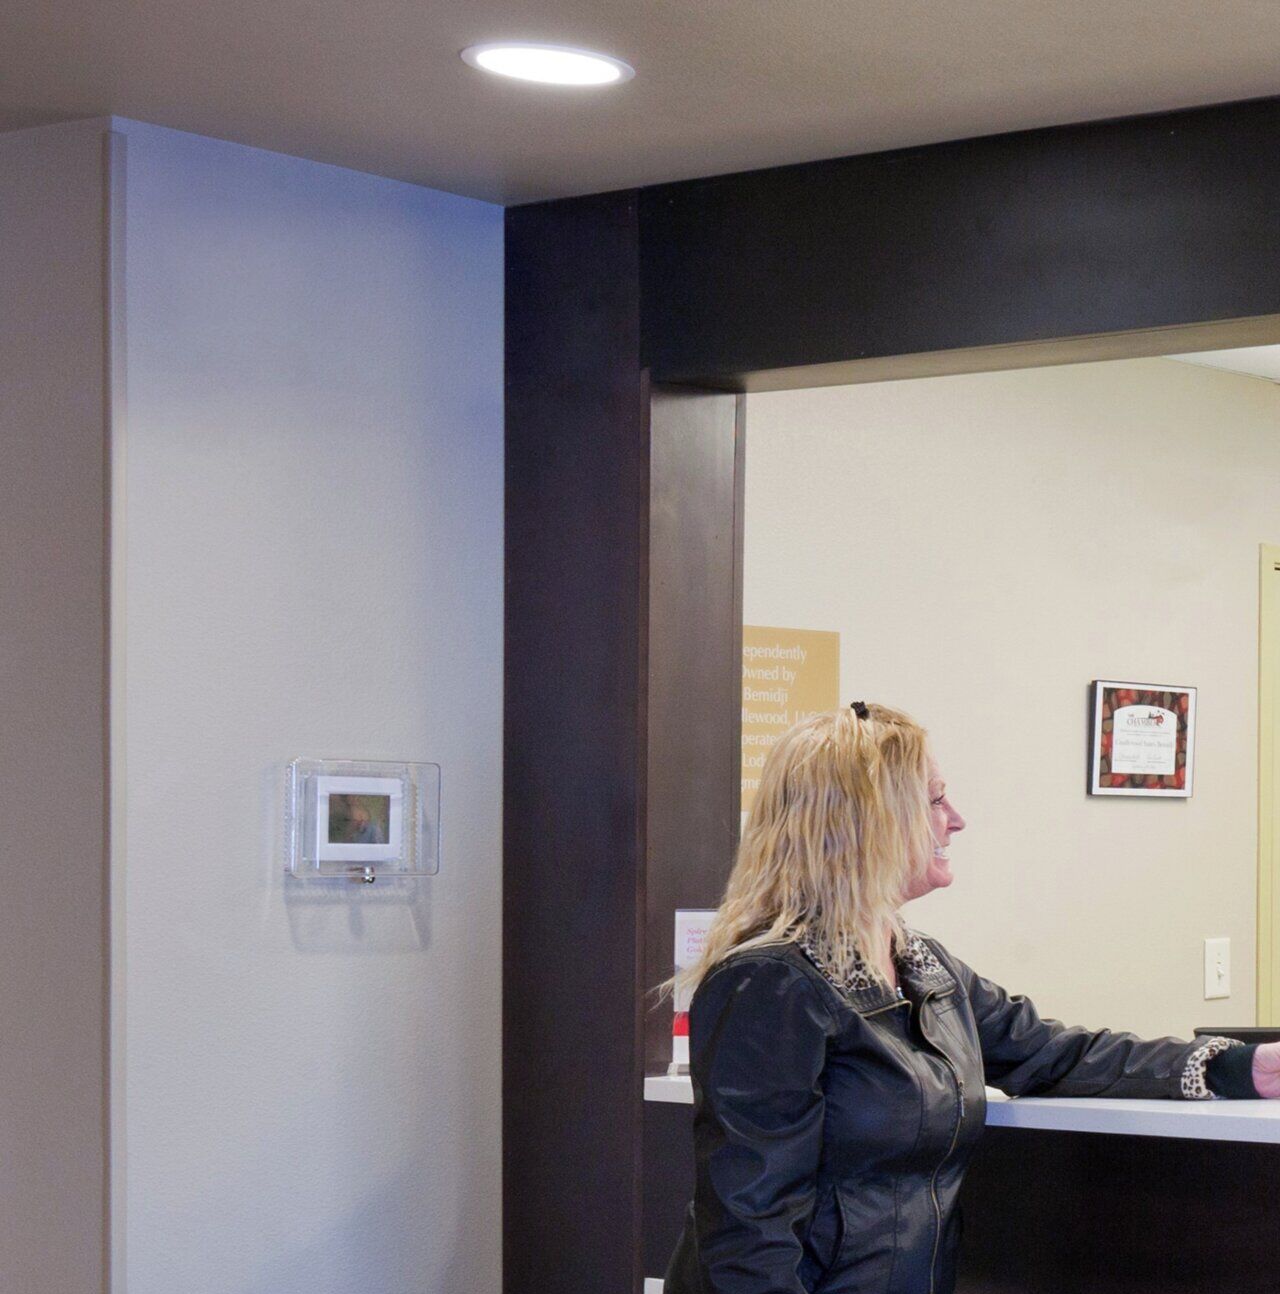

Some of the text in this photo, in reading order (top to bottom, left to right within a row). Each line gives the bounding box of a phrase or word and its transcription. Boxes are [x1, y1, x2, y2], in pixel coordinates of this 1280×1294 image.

[743, 645, 807, 664] ependently
[782, 666, 797, 687] by
[743, 687, 788, 706] Bemidji
